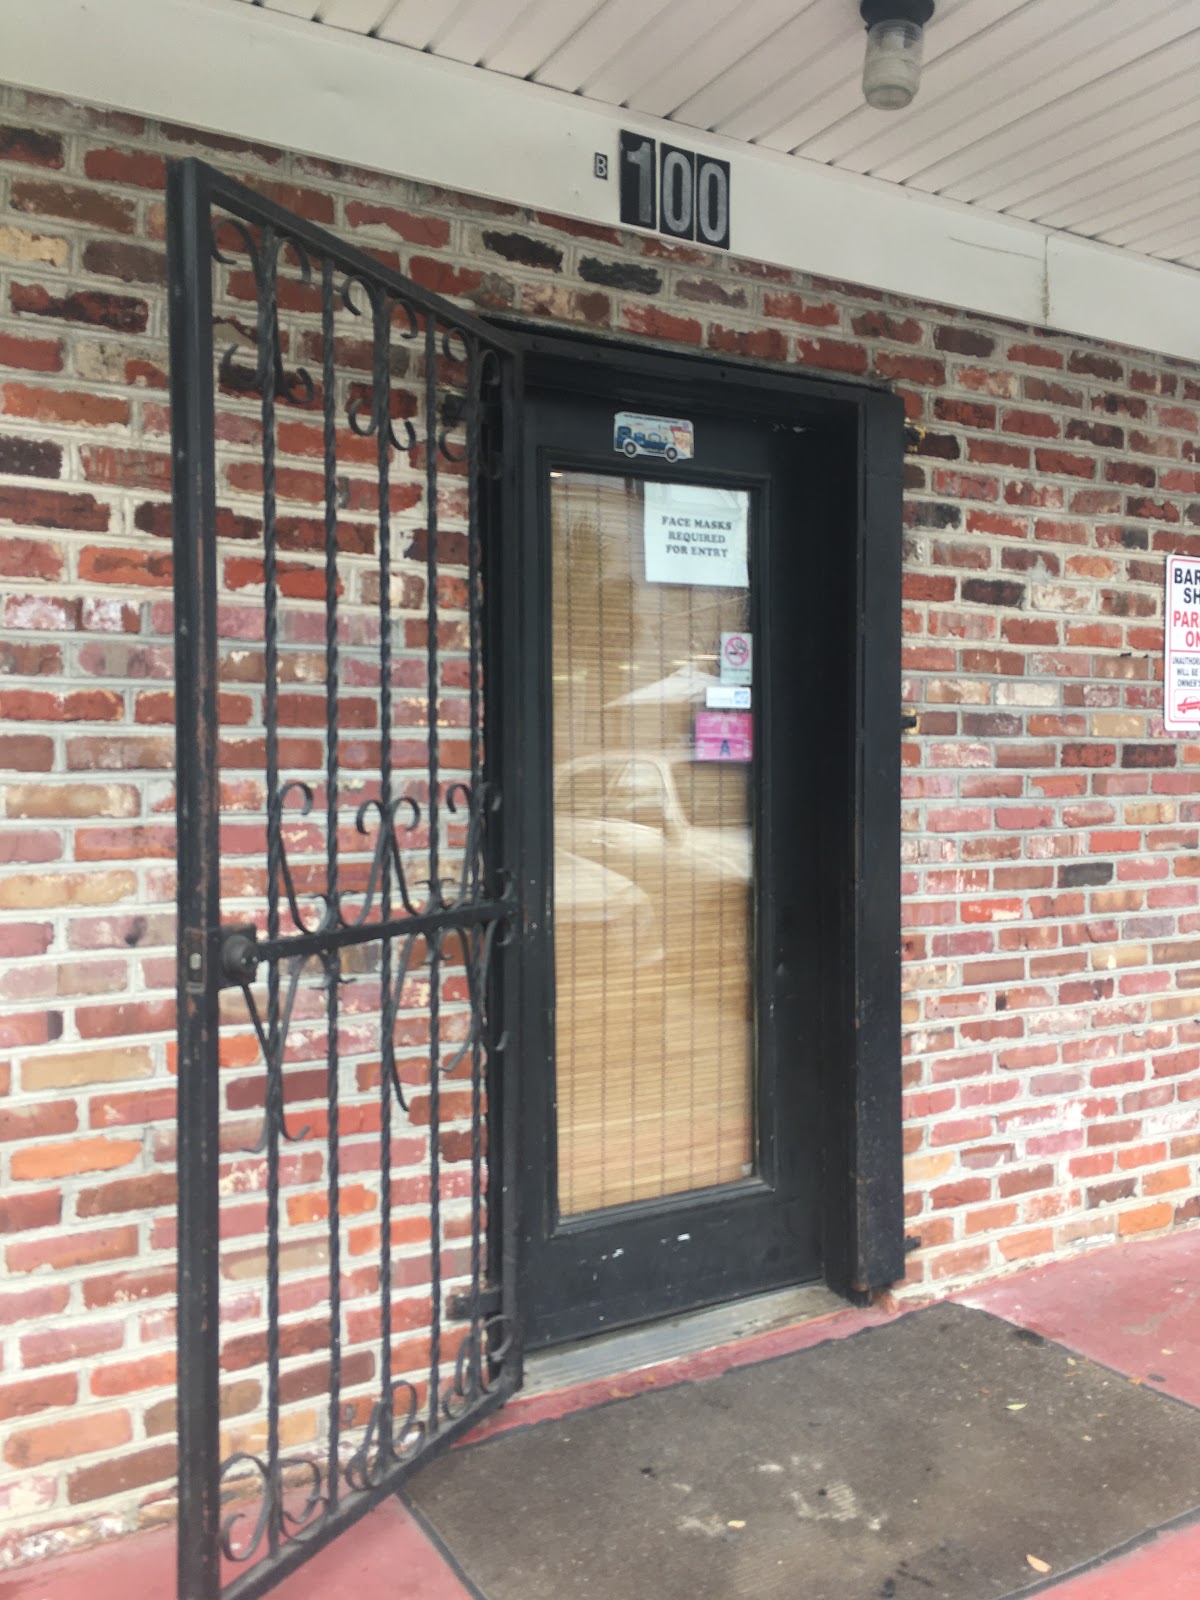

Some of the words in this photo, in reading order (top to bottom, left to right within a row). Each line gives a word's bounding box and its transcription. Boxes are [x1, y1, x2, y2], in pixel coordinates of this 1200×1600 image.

[597, 154, 607, 177] B
[626, 141, 727, 242] 100
[661, 515, 691, 527] FACE
[694, 518, 732, 531] MASKS
[668, 531, 726, 543] REQUIRED
[666, 544, 688, 555] FOR
[691, 546, 728, 558] ENTRY
